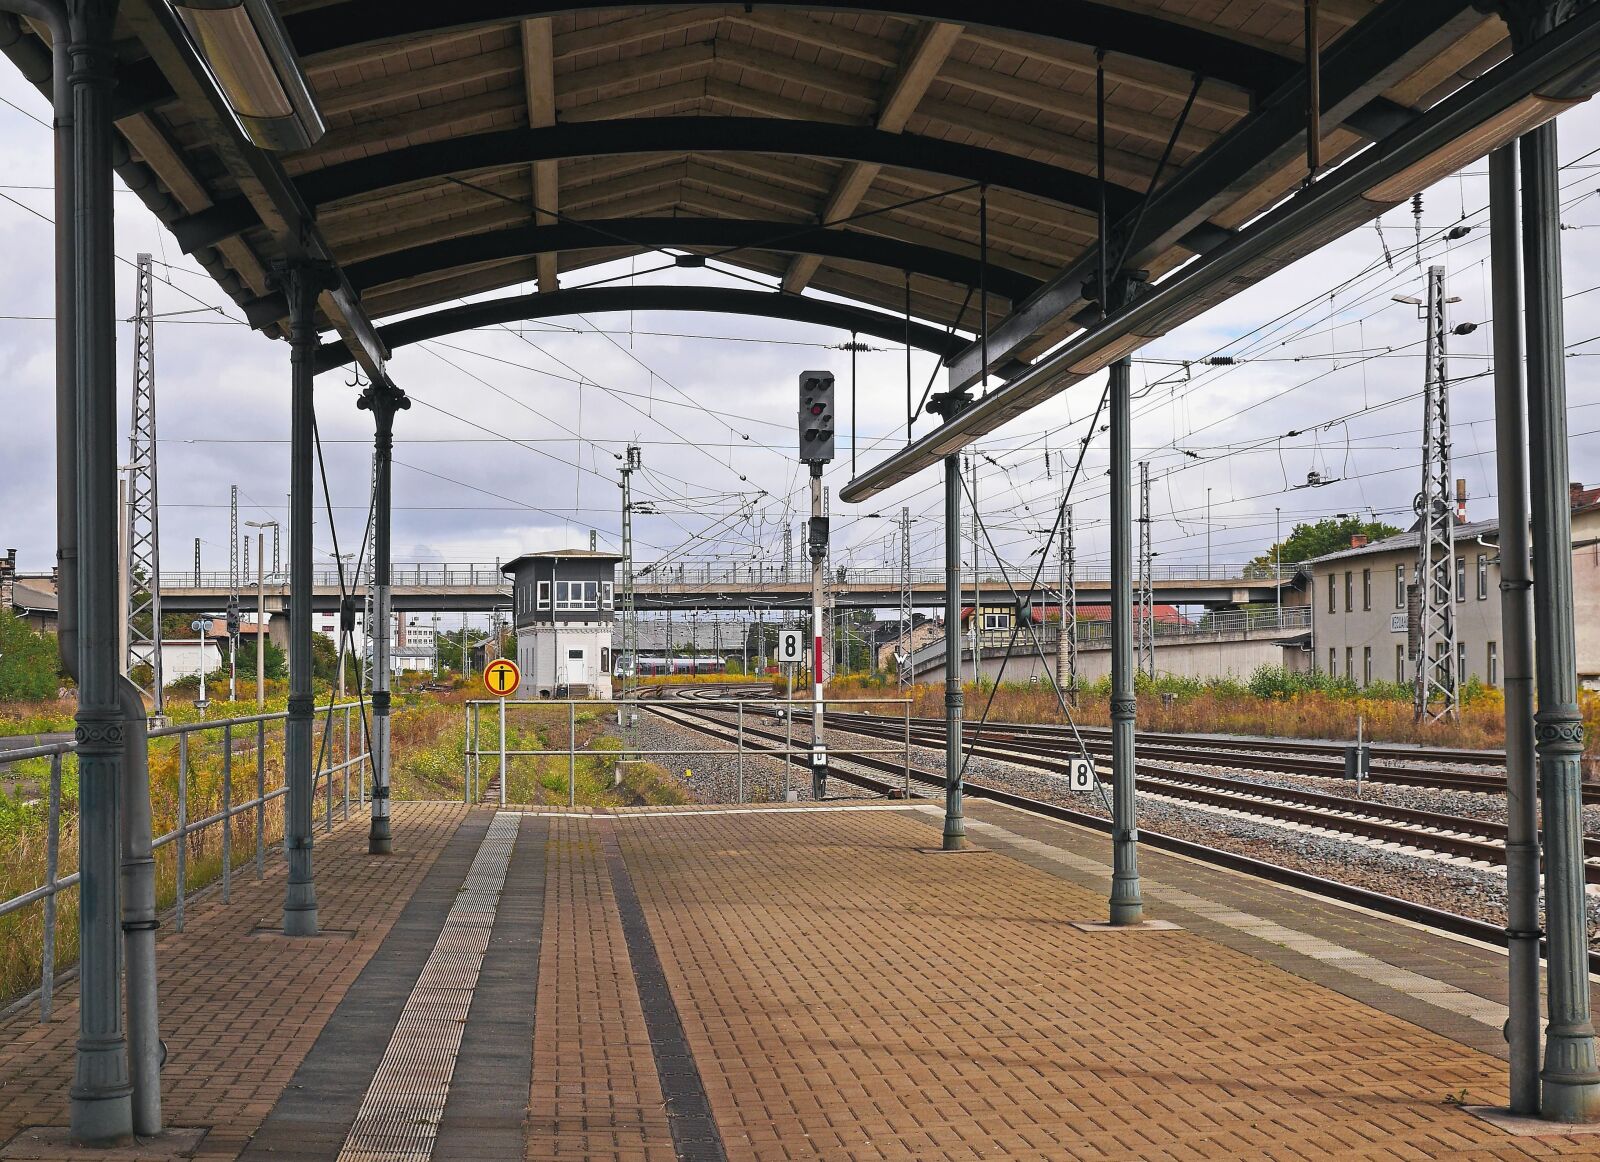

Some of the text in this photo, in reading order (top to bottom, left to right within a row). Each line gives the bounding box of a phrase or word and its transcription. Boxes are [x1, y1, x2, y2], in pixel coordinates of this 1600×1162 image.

[785, 635, 796, 657] 8
[893, 652, 908, 664] W
[1077, 763, 1088, 787] 8
